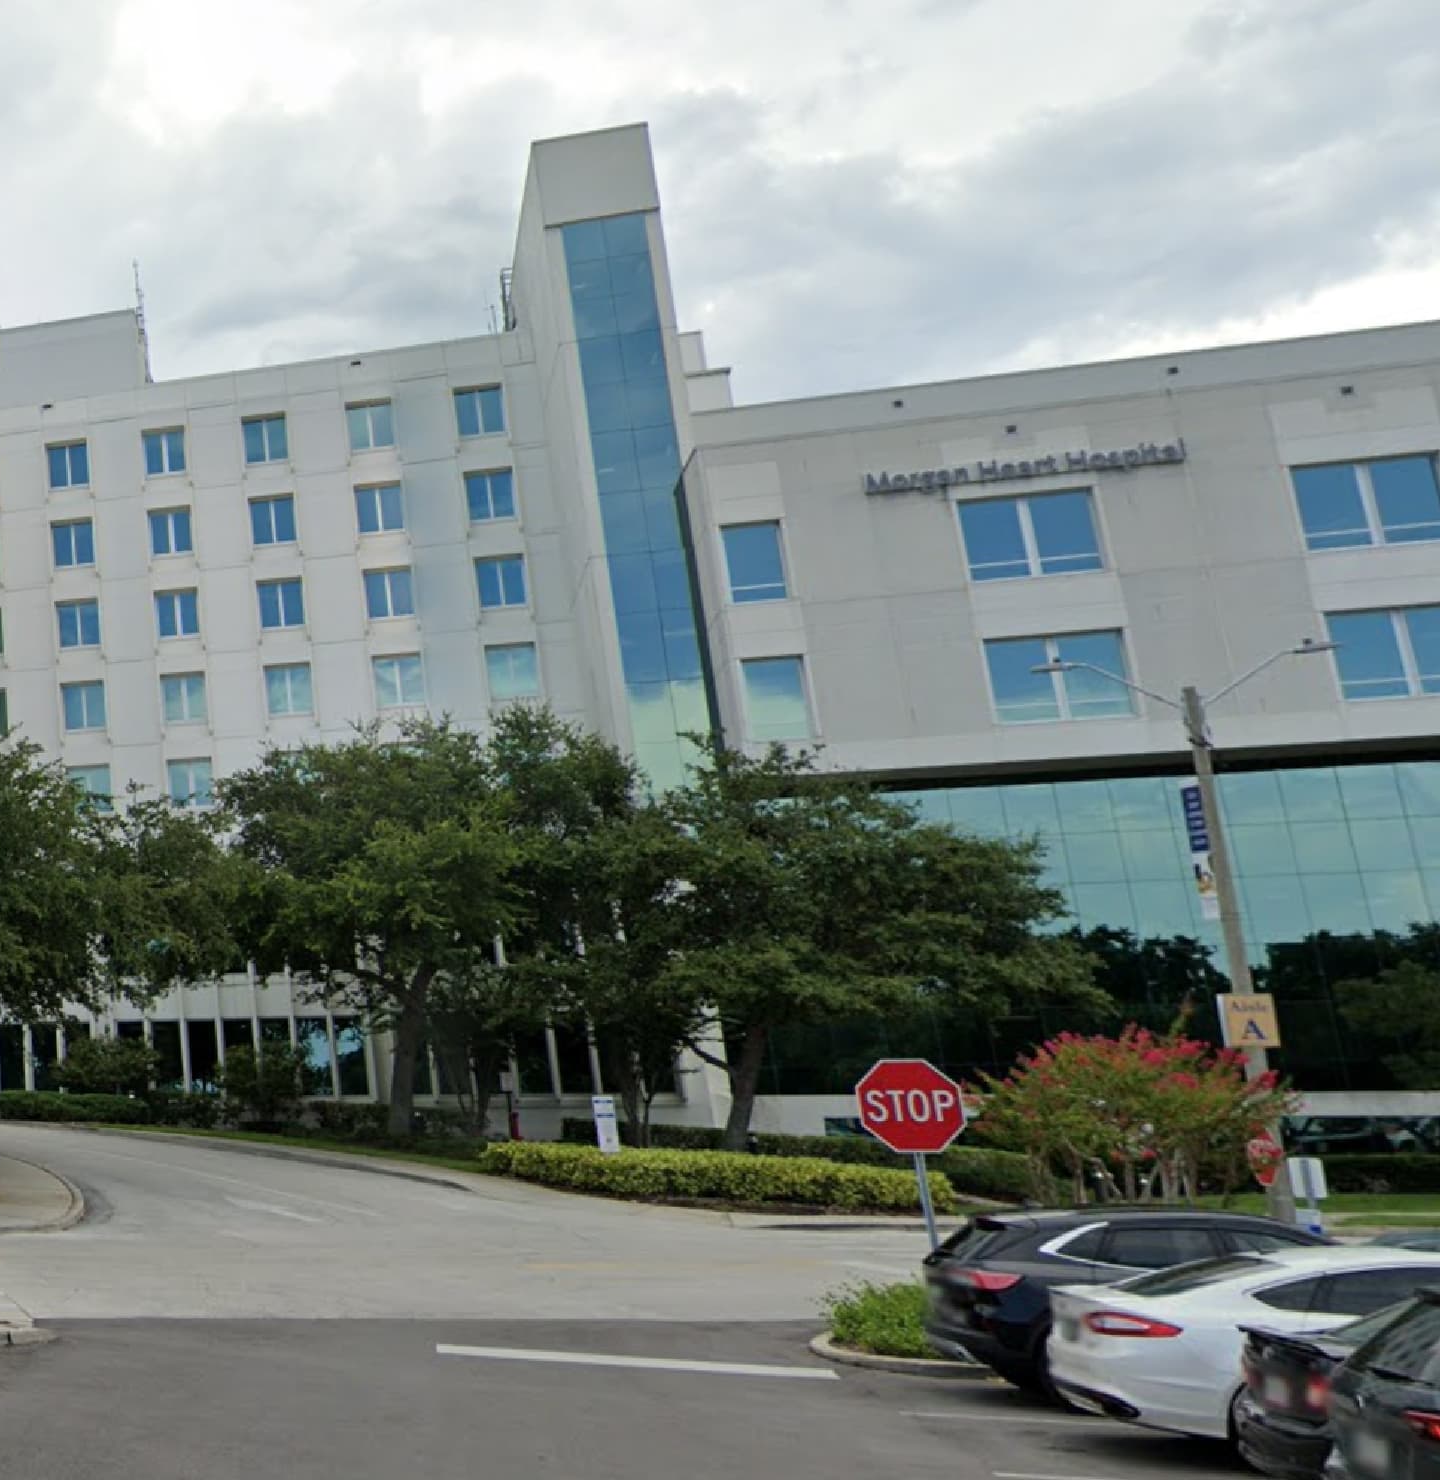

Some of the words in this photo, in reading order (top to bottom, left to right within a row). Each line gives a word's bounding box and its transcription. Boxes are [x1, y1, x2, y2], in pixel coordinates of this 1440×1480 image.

[865, 466, 970, 495] Morgan
[977, 455, 1057, 482] Heart
[1064, 437, 1188, 473] Hospital
[1240, 1019, 1266, 1040] A
[865, 1089, 955, 1123] STOP
